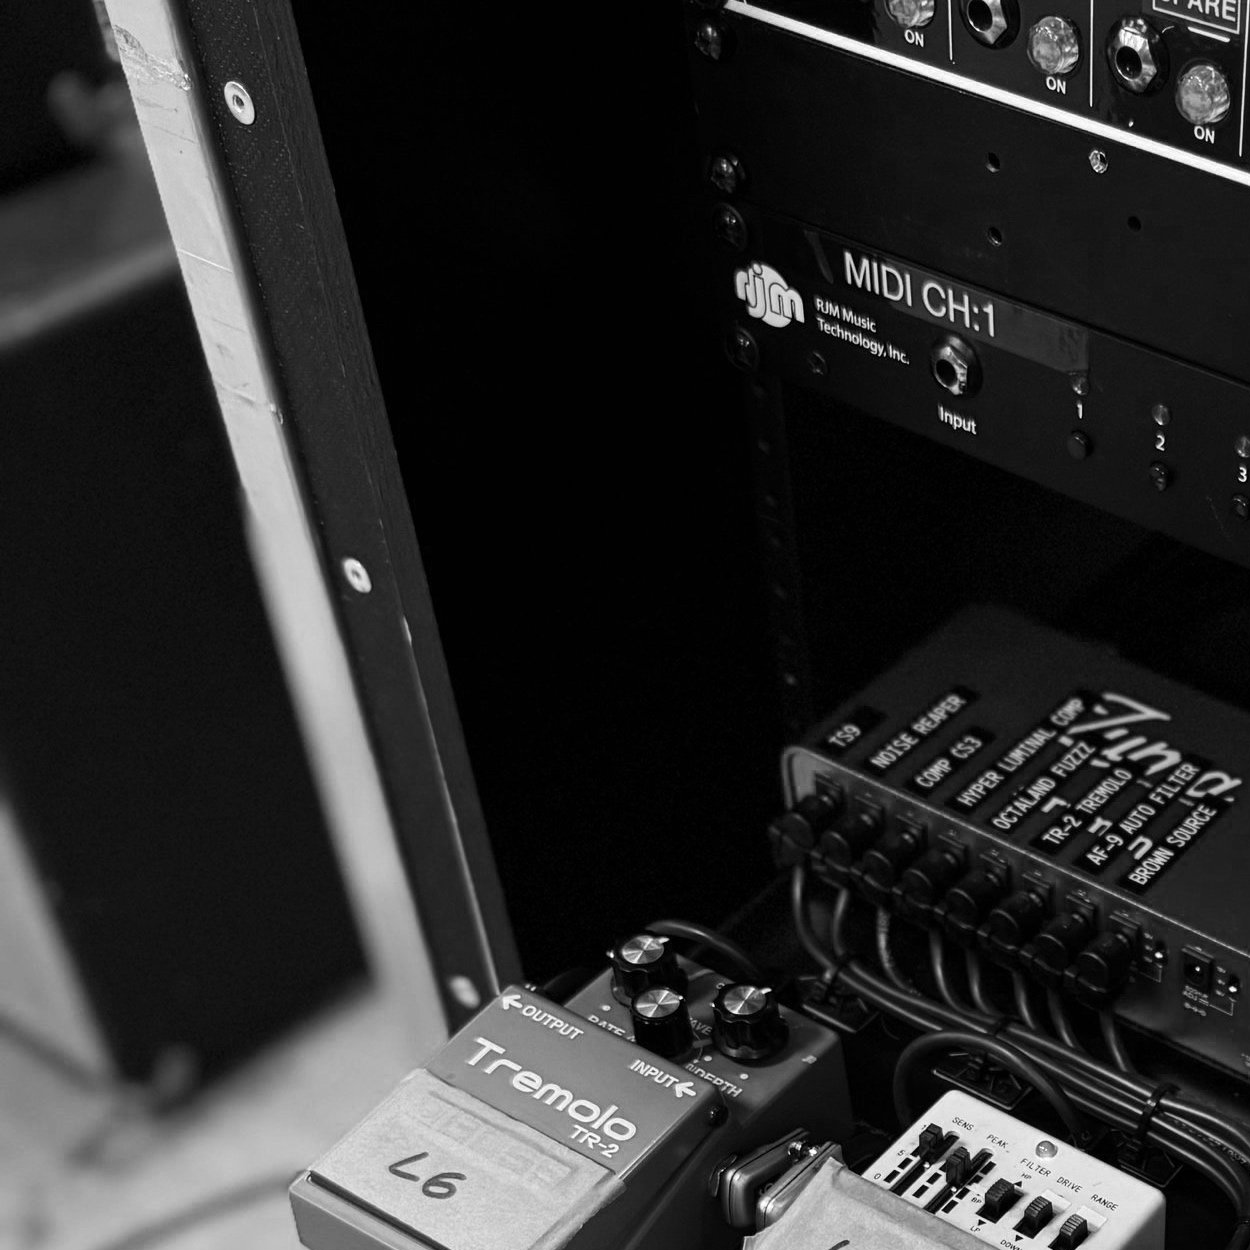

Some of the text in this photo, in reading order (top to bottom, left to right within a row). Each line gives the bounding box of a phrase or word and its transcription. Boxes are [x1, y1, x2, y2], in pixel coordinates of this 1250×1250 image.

[904, 29, 924, 47] ON
[1046, 76, 1066, 94] ON
[1194, 126, 1215, 144] ON
[843, 250, 996, 337] MIDI CH:1
[815, 298, 876, 333] RJM Music
[816, 317, 910, 365] Technology, Inc.
[938, 405, 977, 436] Input
[1076, 402, 1083, 419] 1
[1155, 434, 1165, 452] 2
[1238, 466, 1248, 484] 3
[828, 724, 861, 747] TS9
[870, 694, 967, 768] NOISE REAPER
[915, 735, 982, 787] COMP CS3
[957, 697, 1085, 807] HYPER LUMINAL COMP
[992, 777, 1056, 830] OCTALAND
[1051, 740, 1096, 778] FUZZZ
[1042, 815, 1082, 845] TR-2
[1076, 767, 1133, 814] TREMOLO
[1086, 833, 1124, 866] AF-9
[1119, 803, 1156, 835] AUTO
[1149, 762, 1199, 805] FILTER
[1128, 847, 1174, 885] BROWN
[1166, 804, 1217, 848] SOURCE
[522, 1005, 583, 1040] OUTPUT
[464, 1036, 638, 1142] Tremolo
[629, 1059, 680, 1088] INPUT
[951, 1116, 975, 1131] SENS
[570, 1124, 620, 1159] TR-2
[986, 1133, 1010, 1149] PEAK
[388, 1151, 468, 1200] L6
[1020, 1158, 1052, 1177] FILTER
[1056, 1176, 1083, 1193] DRIVE
[1090, 1194, 1119, 1212] RANGE
[970, 1225, 981, 1233] LP
